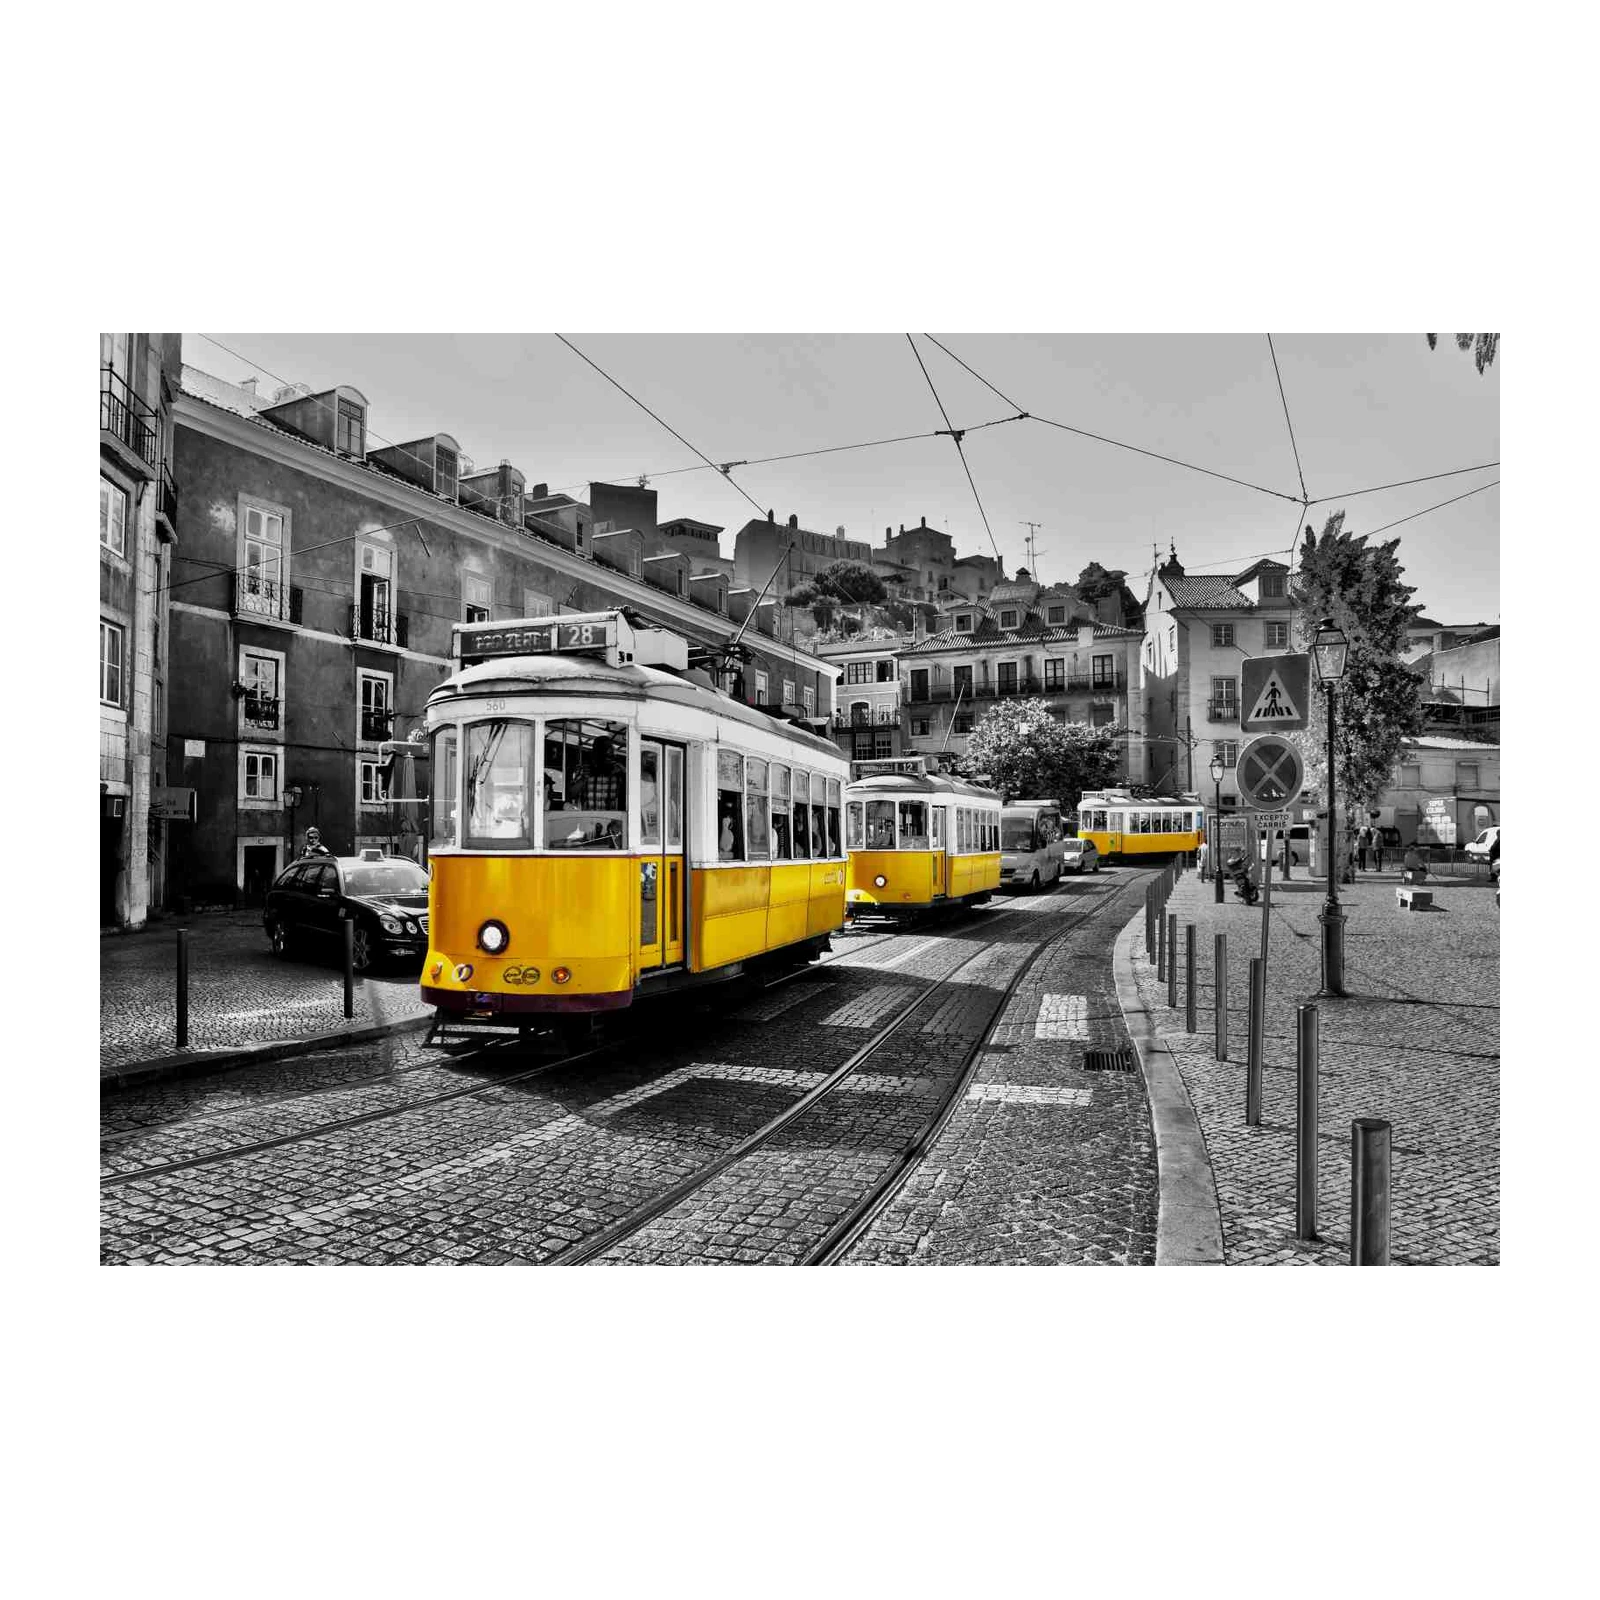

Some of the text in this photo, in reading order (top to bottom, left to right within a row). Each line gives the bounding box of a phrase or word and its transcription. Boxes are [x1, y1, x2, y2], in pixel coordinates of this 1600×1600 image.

[568, 625, 594, 646] 28
[486, 700, 506, 711] 560
[903, 762, 913, 772] 12
[1256, 821, 1287, 829] CARRIS
